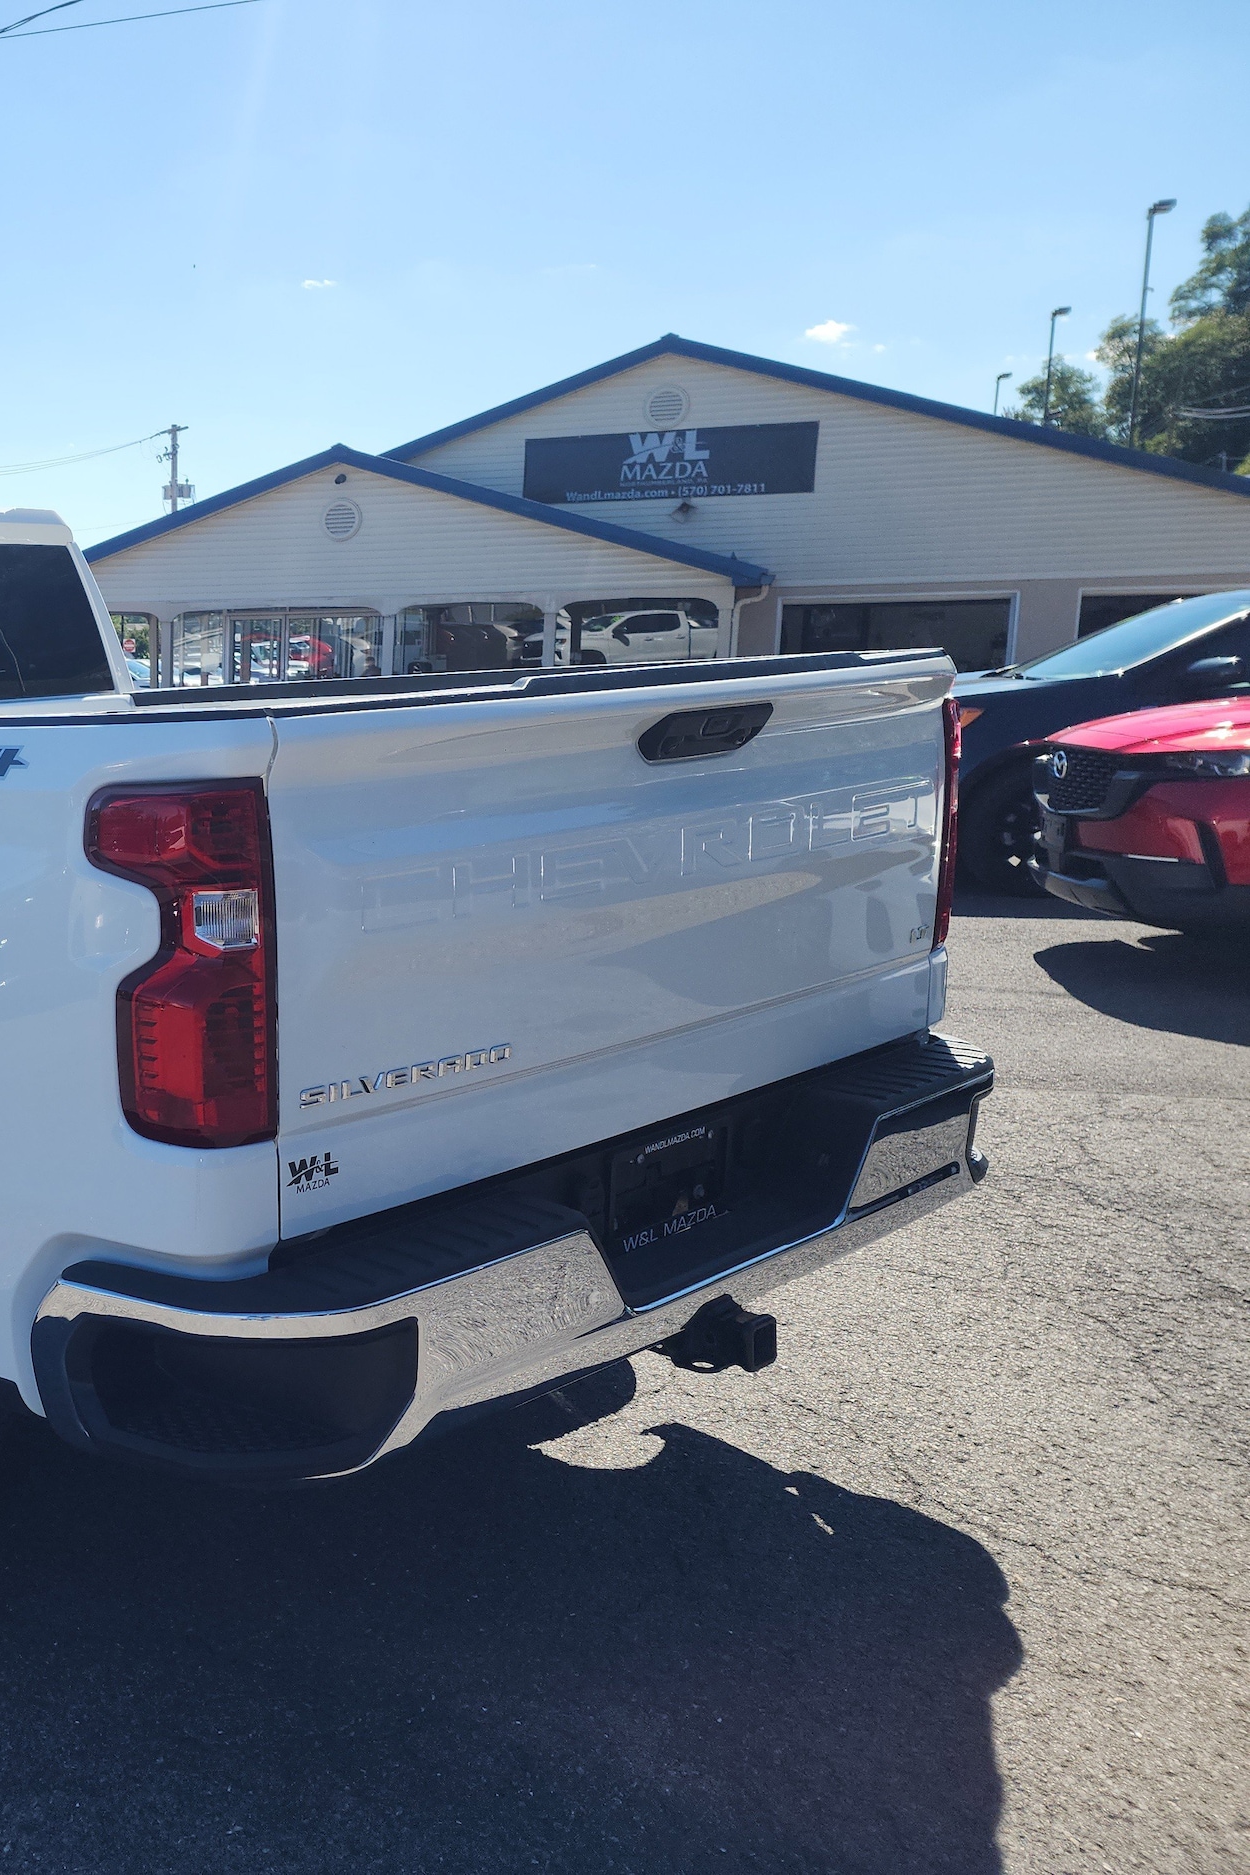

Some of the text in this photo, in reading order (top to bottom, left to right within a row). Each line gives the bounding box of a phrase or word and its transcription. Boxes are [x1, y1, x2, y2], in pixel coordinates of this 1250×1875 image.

[623, 430, 710, 464] W&L
[620, 461, 709, 481] MAZDA
[566, 483, 765, 503] WandLmazda.com (570) 701-7811
[360, 778, 934, 934] CHEVROLET
[299, 1043, 512, 1109] SILVERADO
[644, 1126, 706, 1154] WANDLMAZDA.COM
[286, 1152, 339, 1187] W&L
[296, 1177, 330, 1194] MAZDA
[623, 1204, 716, 1252] W&L MAZDA
